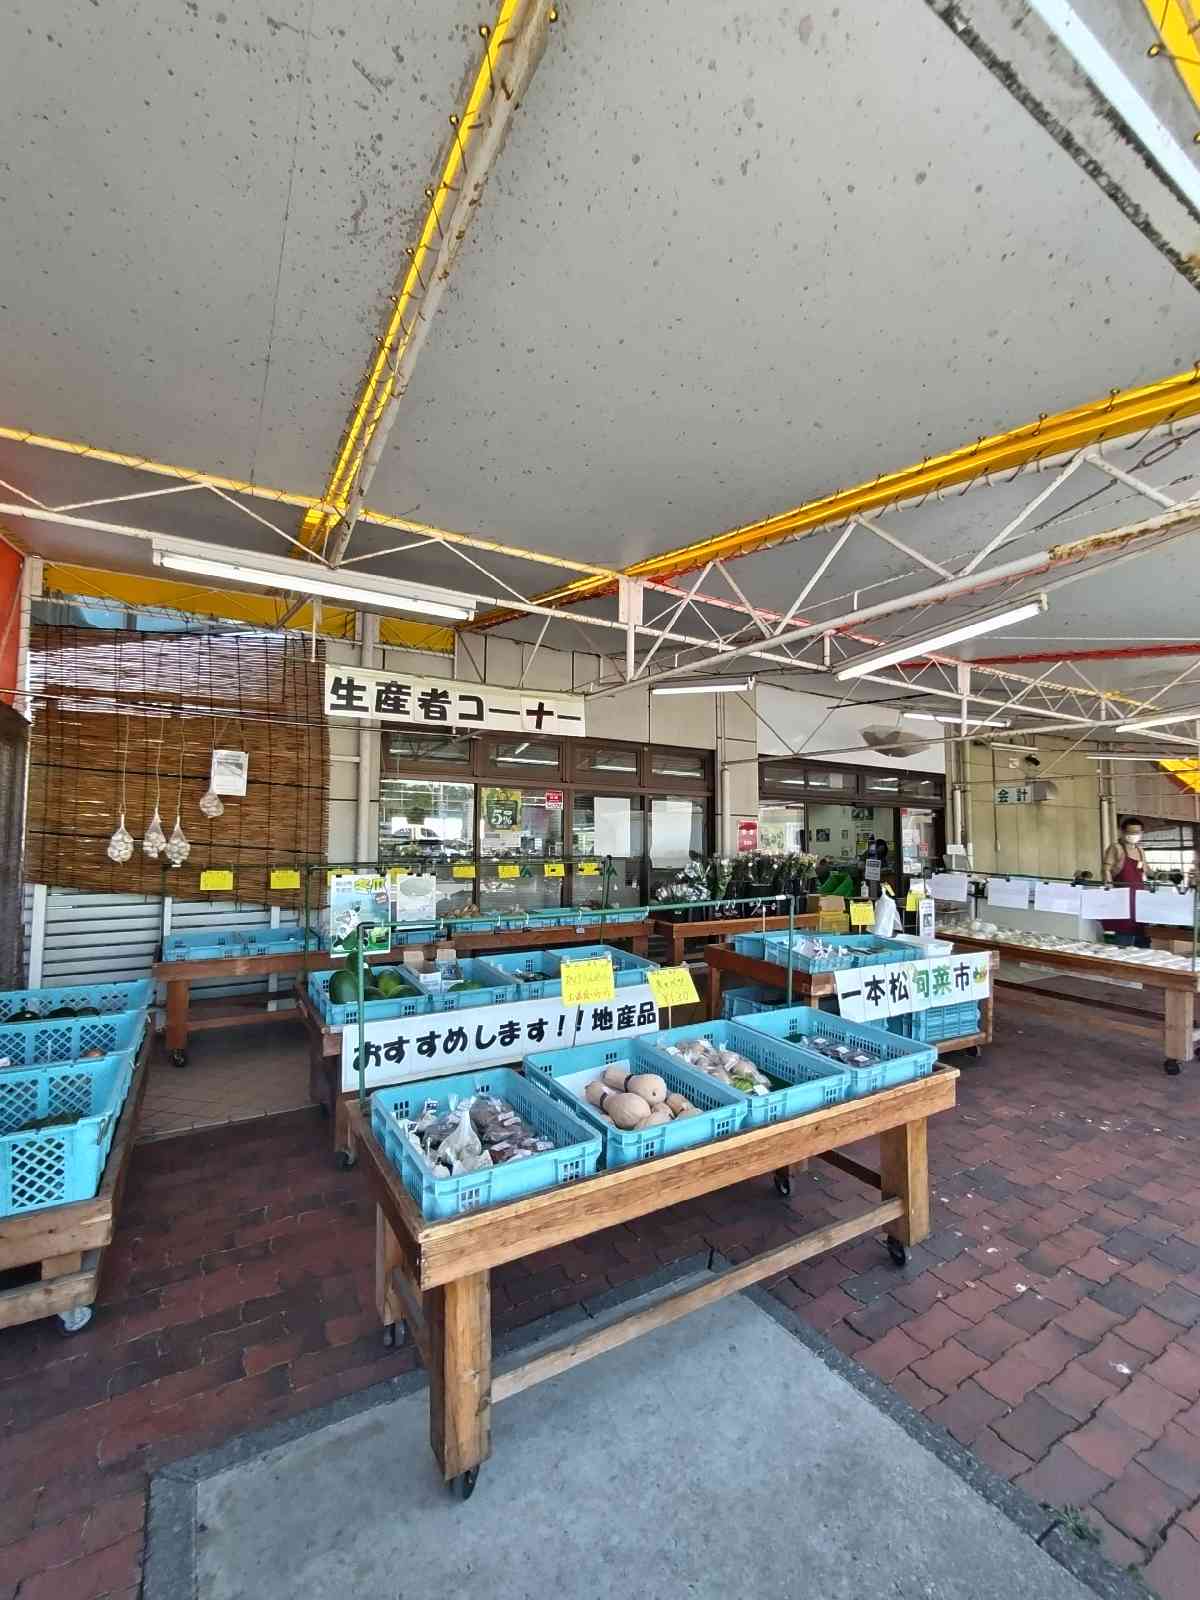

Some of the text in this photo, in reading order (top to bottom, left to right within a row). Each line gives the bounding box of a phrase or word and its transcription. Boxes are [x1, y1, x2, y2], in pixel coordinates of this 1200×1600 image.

[998, 788, 1028, 802] 会計
[841, 962, 970, 1007] 一本松旬菜市
